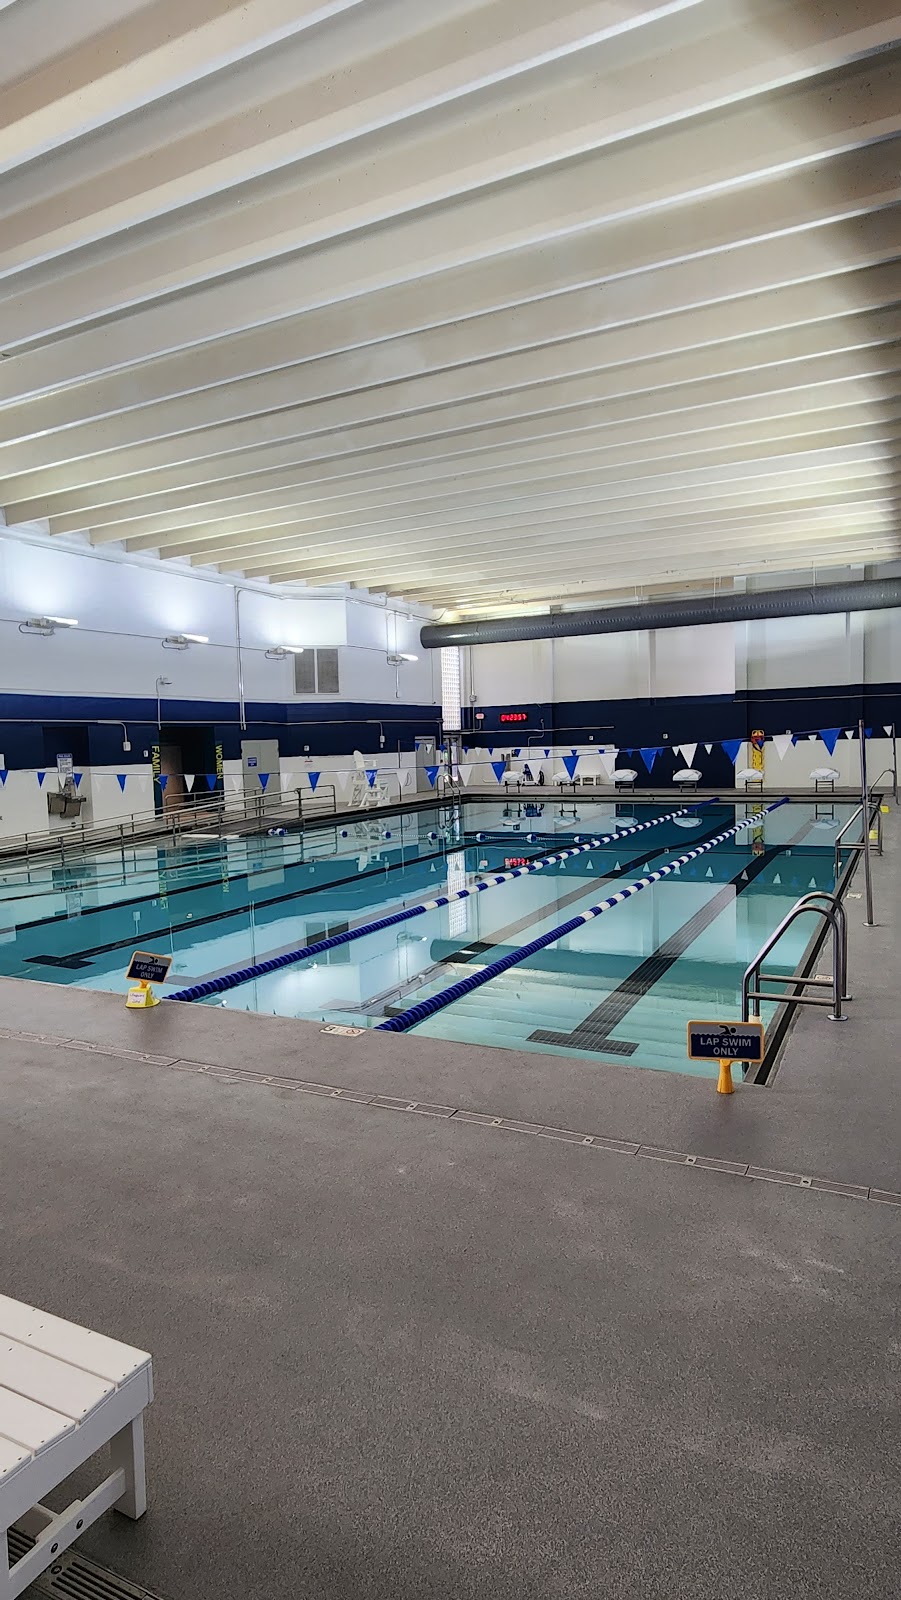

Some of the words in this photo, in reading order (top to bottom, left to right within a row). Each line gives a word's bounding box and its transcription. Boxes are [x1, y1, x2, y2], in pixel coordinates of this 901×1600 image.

[151, 745, 161, 785] FAMILY
[215, 744, 224, 780] WOMEN
[136, 963, 147, 971] LAP
[147, 965, 164, 973] SWIM
[140, 971, 155, 979] ONLY
[700, 1037, 720, 1046] LAP
[722, 1037, 752, 1047] SWIM
[713, 1047, 739, 1056] ONLY
